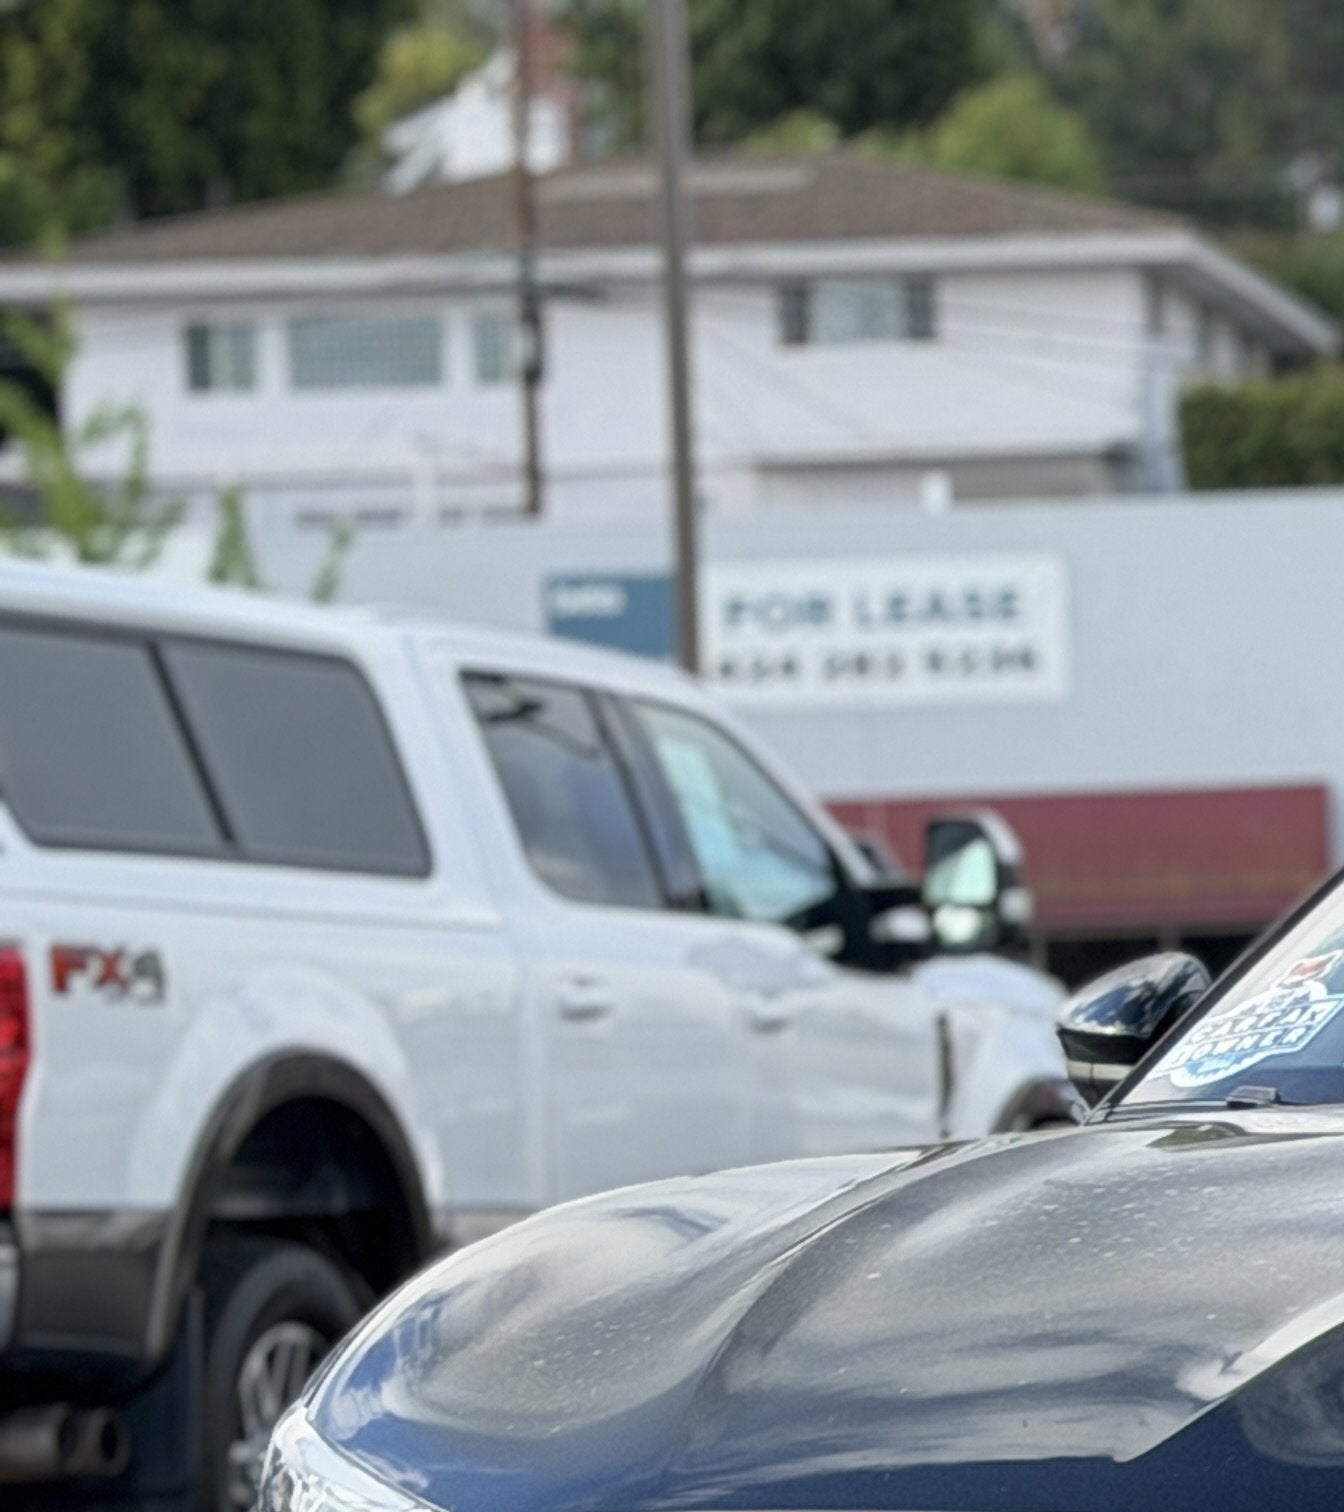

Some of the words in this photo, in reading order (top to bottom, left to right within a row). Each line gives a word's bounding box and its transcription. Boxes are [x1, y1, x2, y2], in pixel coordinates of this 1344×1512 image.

[724, 586, 834, 630] FOR
[854, 581, 1022, 627] LEASE
[47, 942, 165, 1004] FX4
[1191, 1003, 1327, 1043] CARFAX
